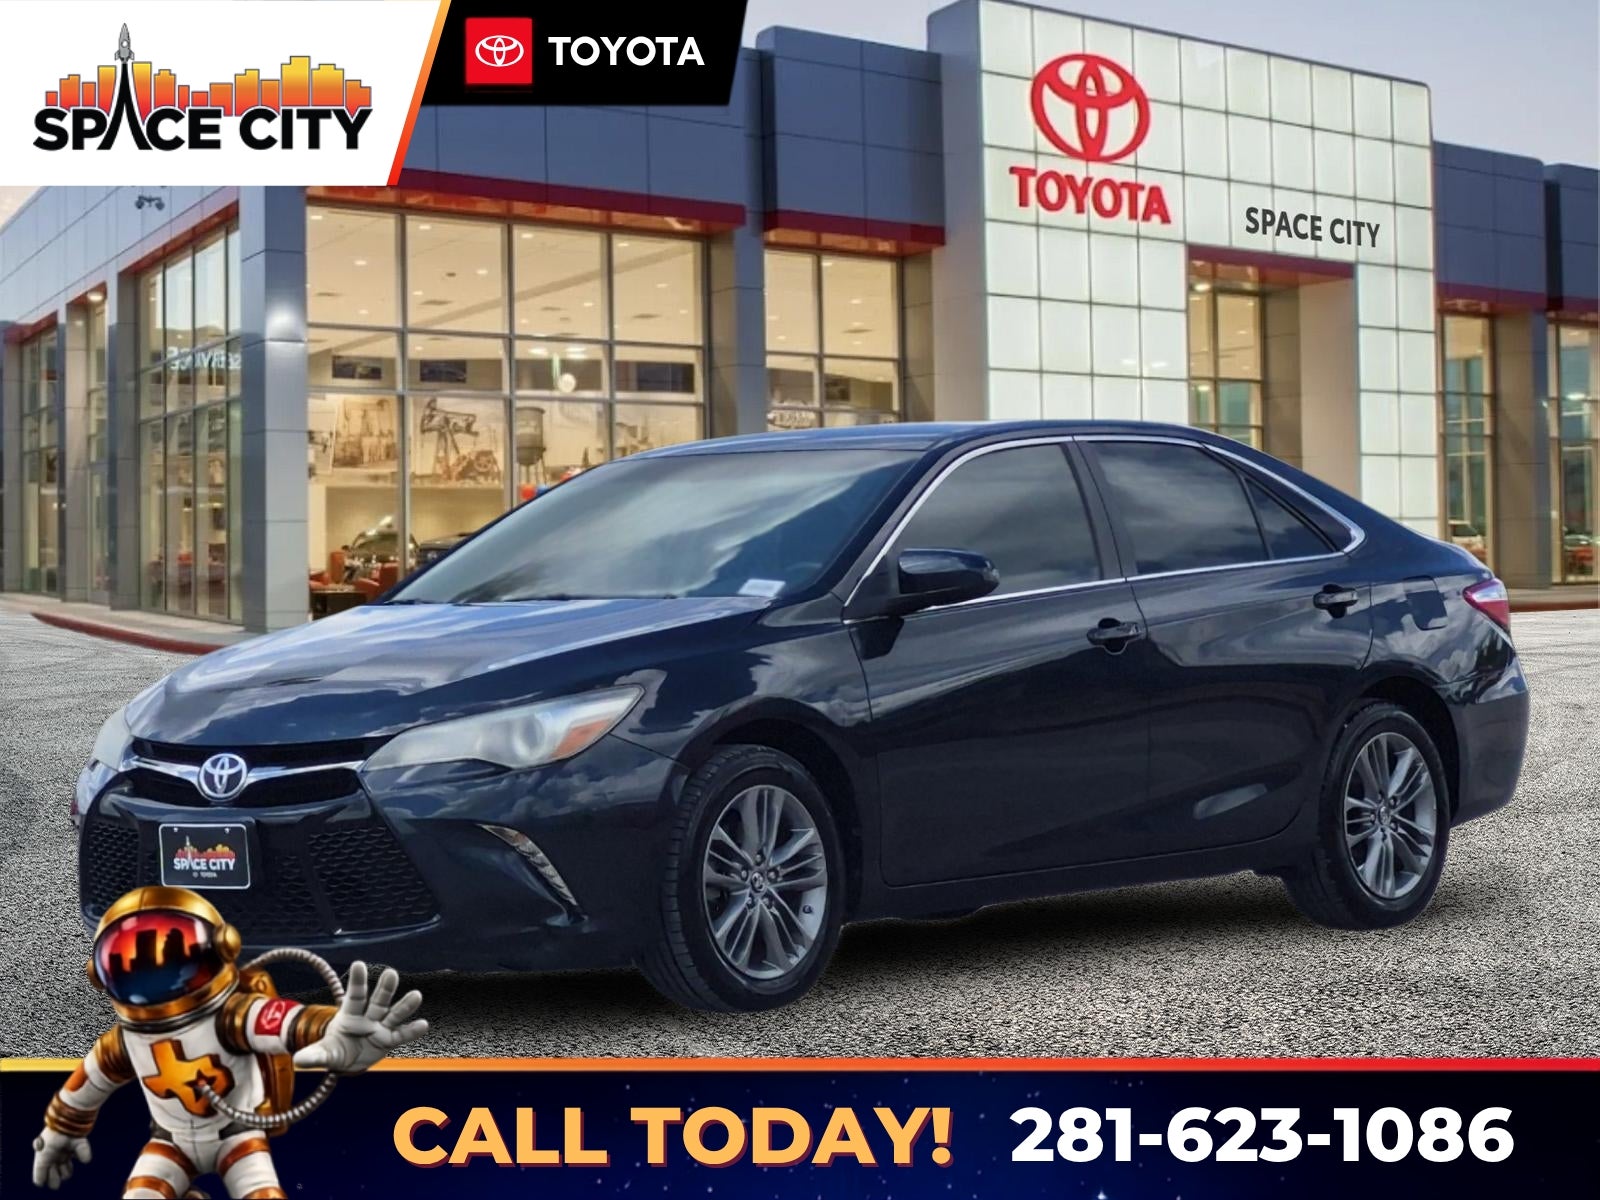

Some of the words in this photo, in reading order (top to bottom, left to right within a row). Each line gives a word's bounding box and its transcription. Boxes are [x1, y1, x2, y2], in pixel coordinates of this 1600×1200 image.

[1009, 166, 1171, 225] TOYOTA
[1245, 206, 1323, 242] SPACE
[1329, 217, 1381, 248] CITY
[173, 857, 208, 871] SPACE
[208, 857, 236, 871] CITY
